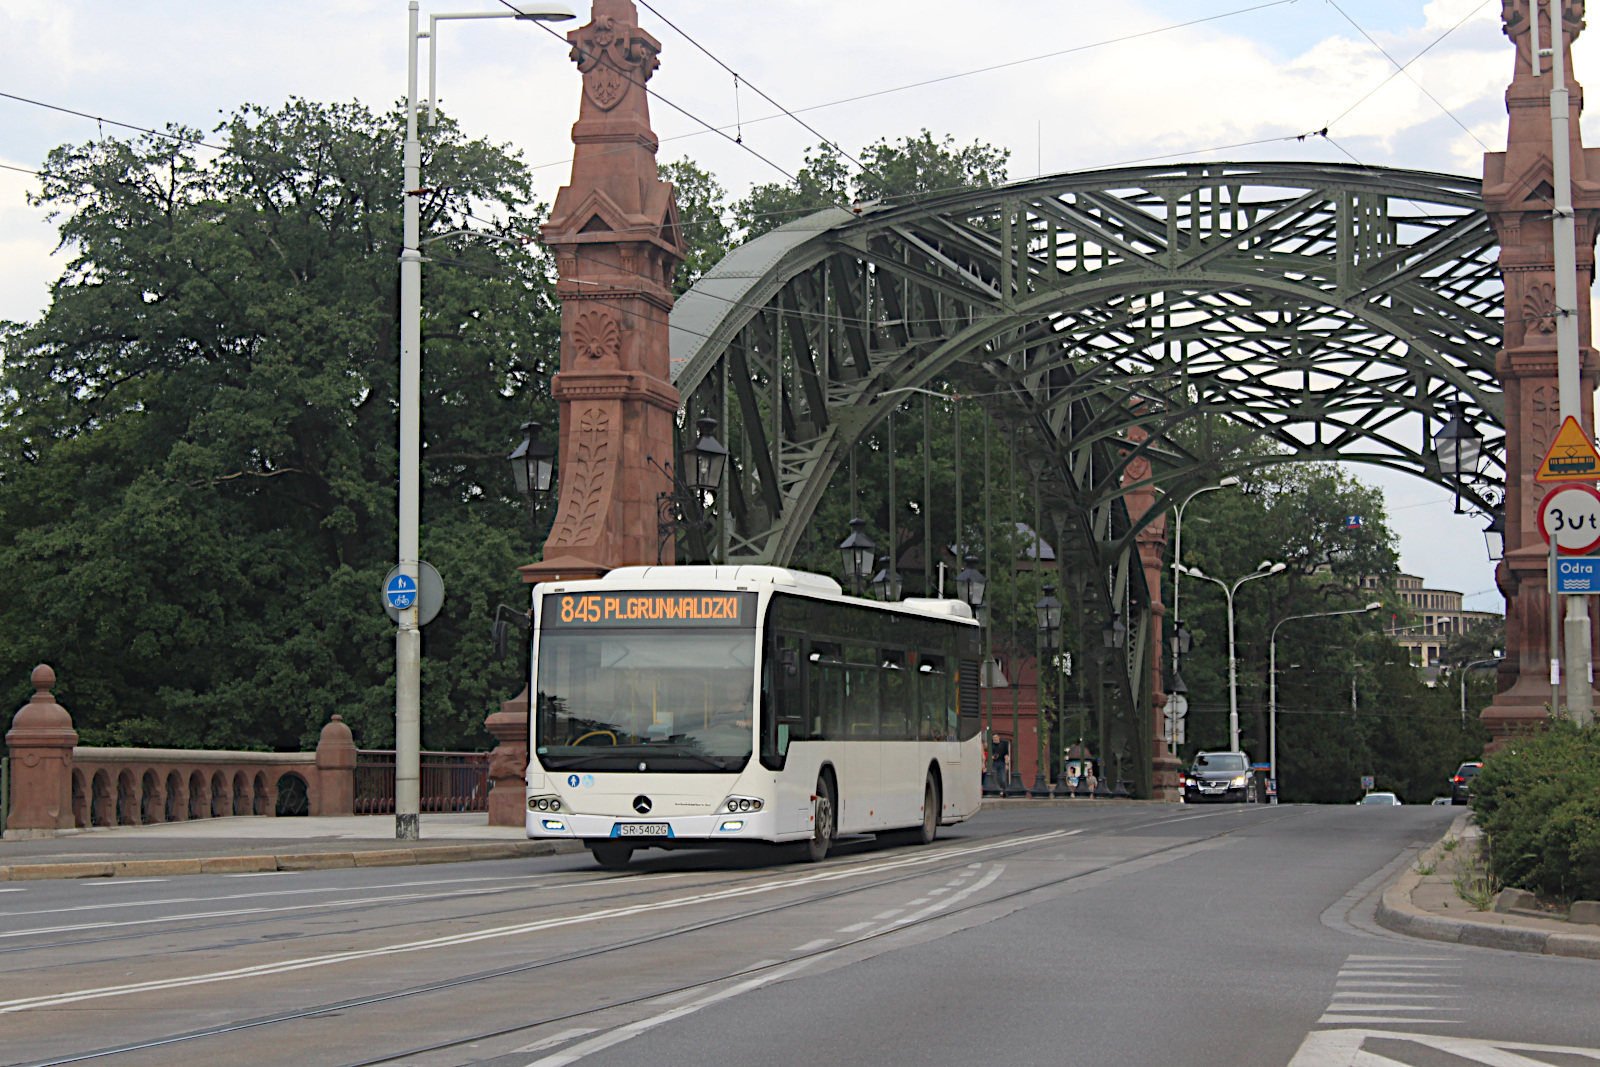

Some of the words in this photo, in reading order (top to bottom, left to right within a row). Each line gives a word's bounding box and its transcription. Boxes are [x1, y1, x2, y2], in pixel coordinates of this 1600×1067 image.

[1560, 562, 1593, 574] Odra
[560, 595, 601, 623] 845
[604, 597, 738, 619] PL.GRUNWALDZKI
[622, 825, 636, 835] SR
[638, 825, 667, 835] 5402G
